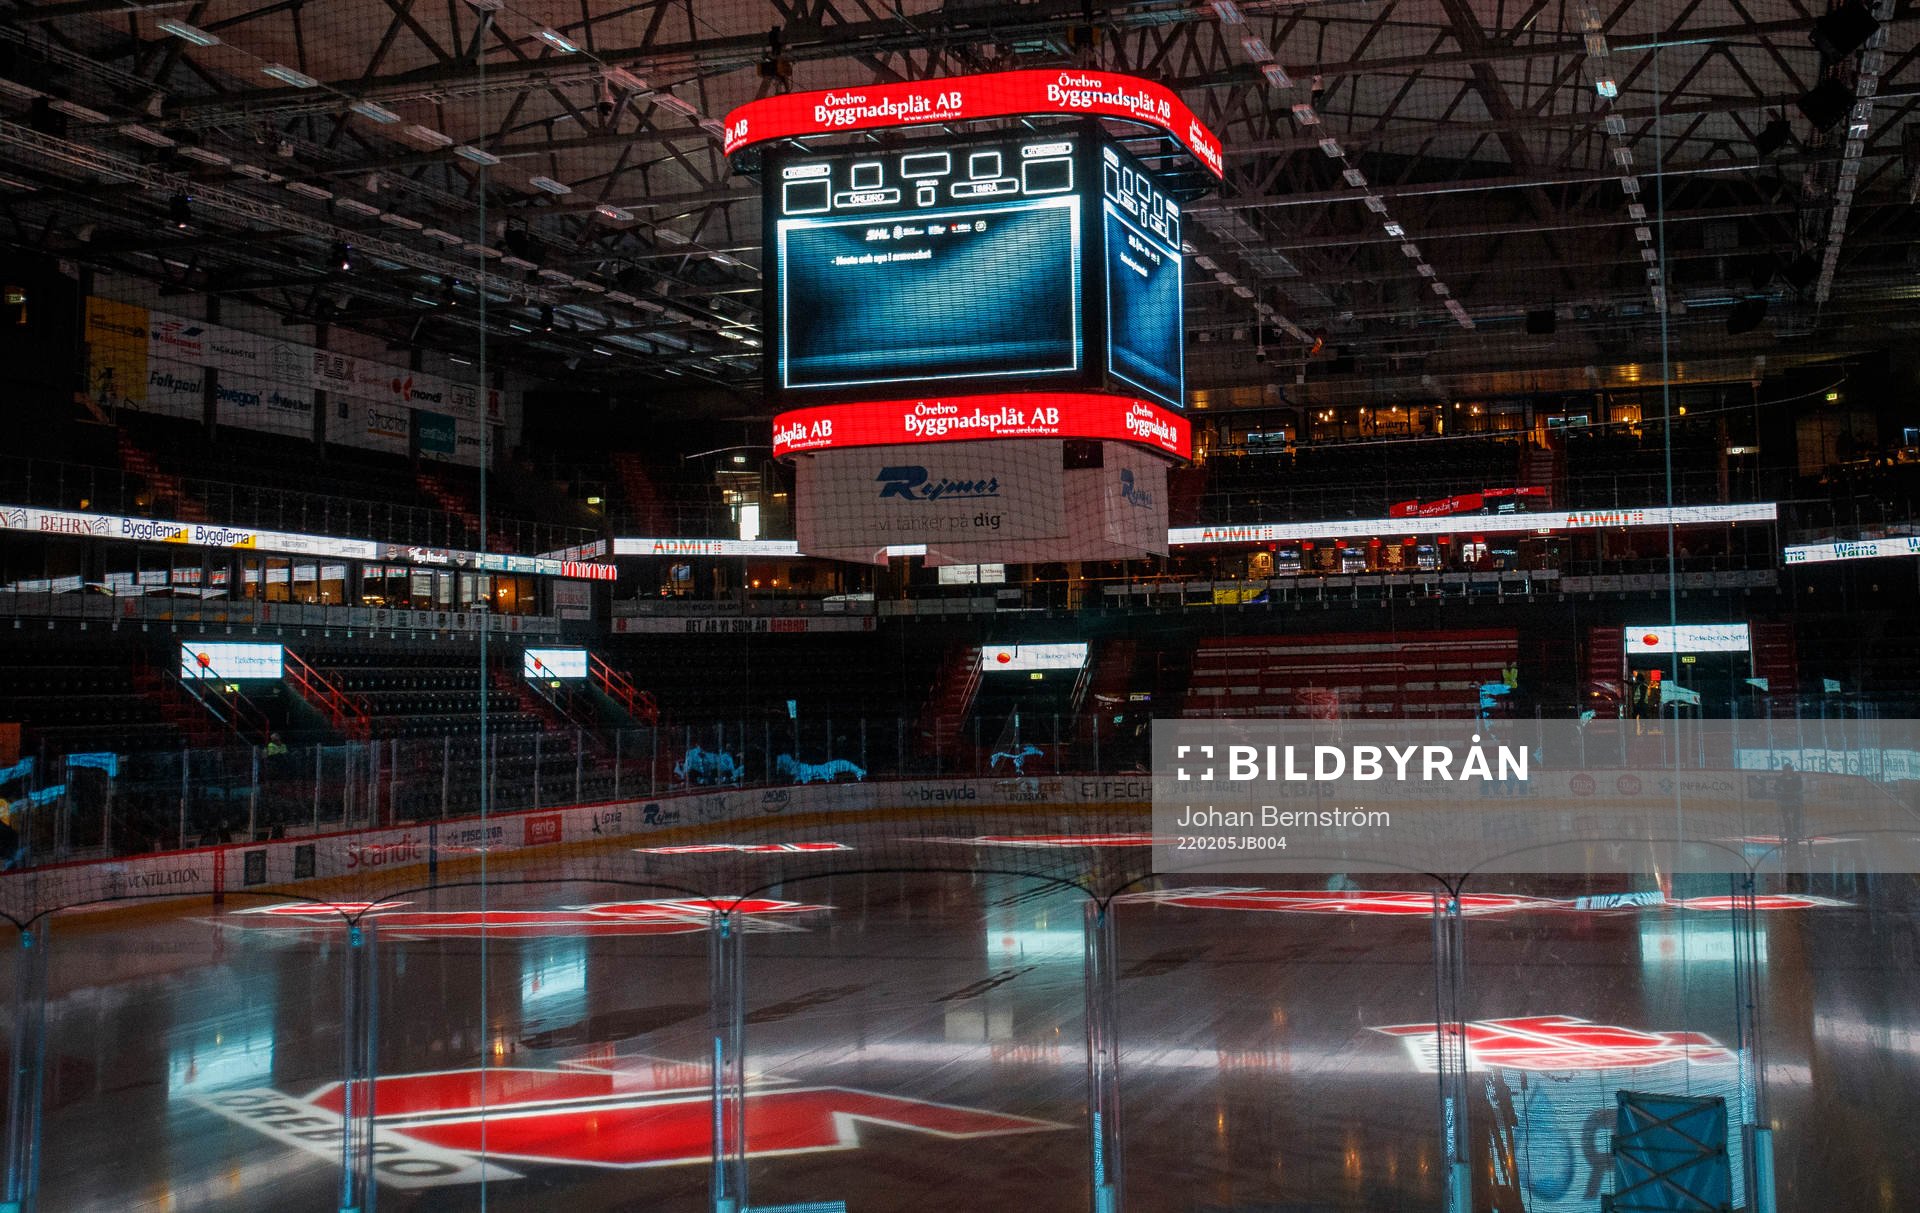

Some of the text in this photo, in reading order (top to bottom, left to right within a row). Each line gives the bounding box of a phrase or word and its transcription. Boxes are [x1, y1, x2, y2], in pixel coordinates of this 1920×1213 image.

[1058, 72, 1101, 88] Örebro
[825, 93, 866, 106] Örebro
[1047, 84, 1170, 118] Byggnadsplåt AB
[815, 92, 963, 126] Byggnadsplåt AB
[734, 119, 748, 139] AB
[850, 193, 885, 204] ÖREBRO
[866, 229, 890, 240] SHL
[411, 389, 442, 404] mondi
[916, 402, 958, 416] Örebro
[810, 419, 832, 438] AB
[905, 407, 1060, 437] Byggnadsplåt AB
[41, 515, 94, 535] BEHRN
[973, 512, 1001, 530] dig
[1565, 509, 1632, 528] ADMIT
[123, 518, 250, 547] ByggTema ByggTema
[1201, 527, 1261, 542] ADMIT
[653, 540, 711, 554] ADMIT
[1833, 543, 1877, 559] Wärna
[920, 784, 977, 802] bravida
[461, 827, 503, 843] PISCTOR
[346, 833, 423, 869] Scandic
[127, 868, 200, 889] VENTILATION
